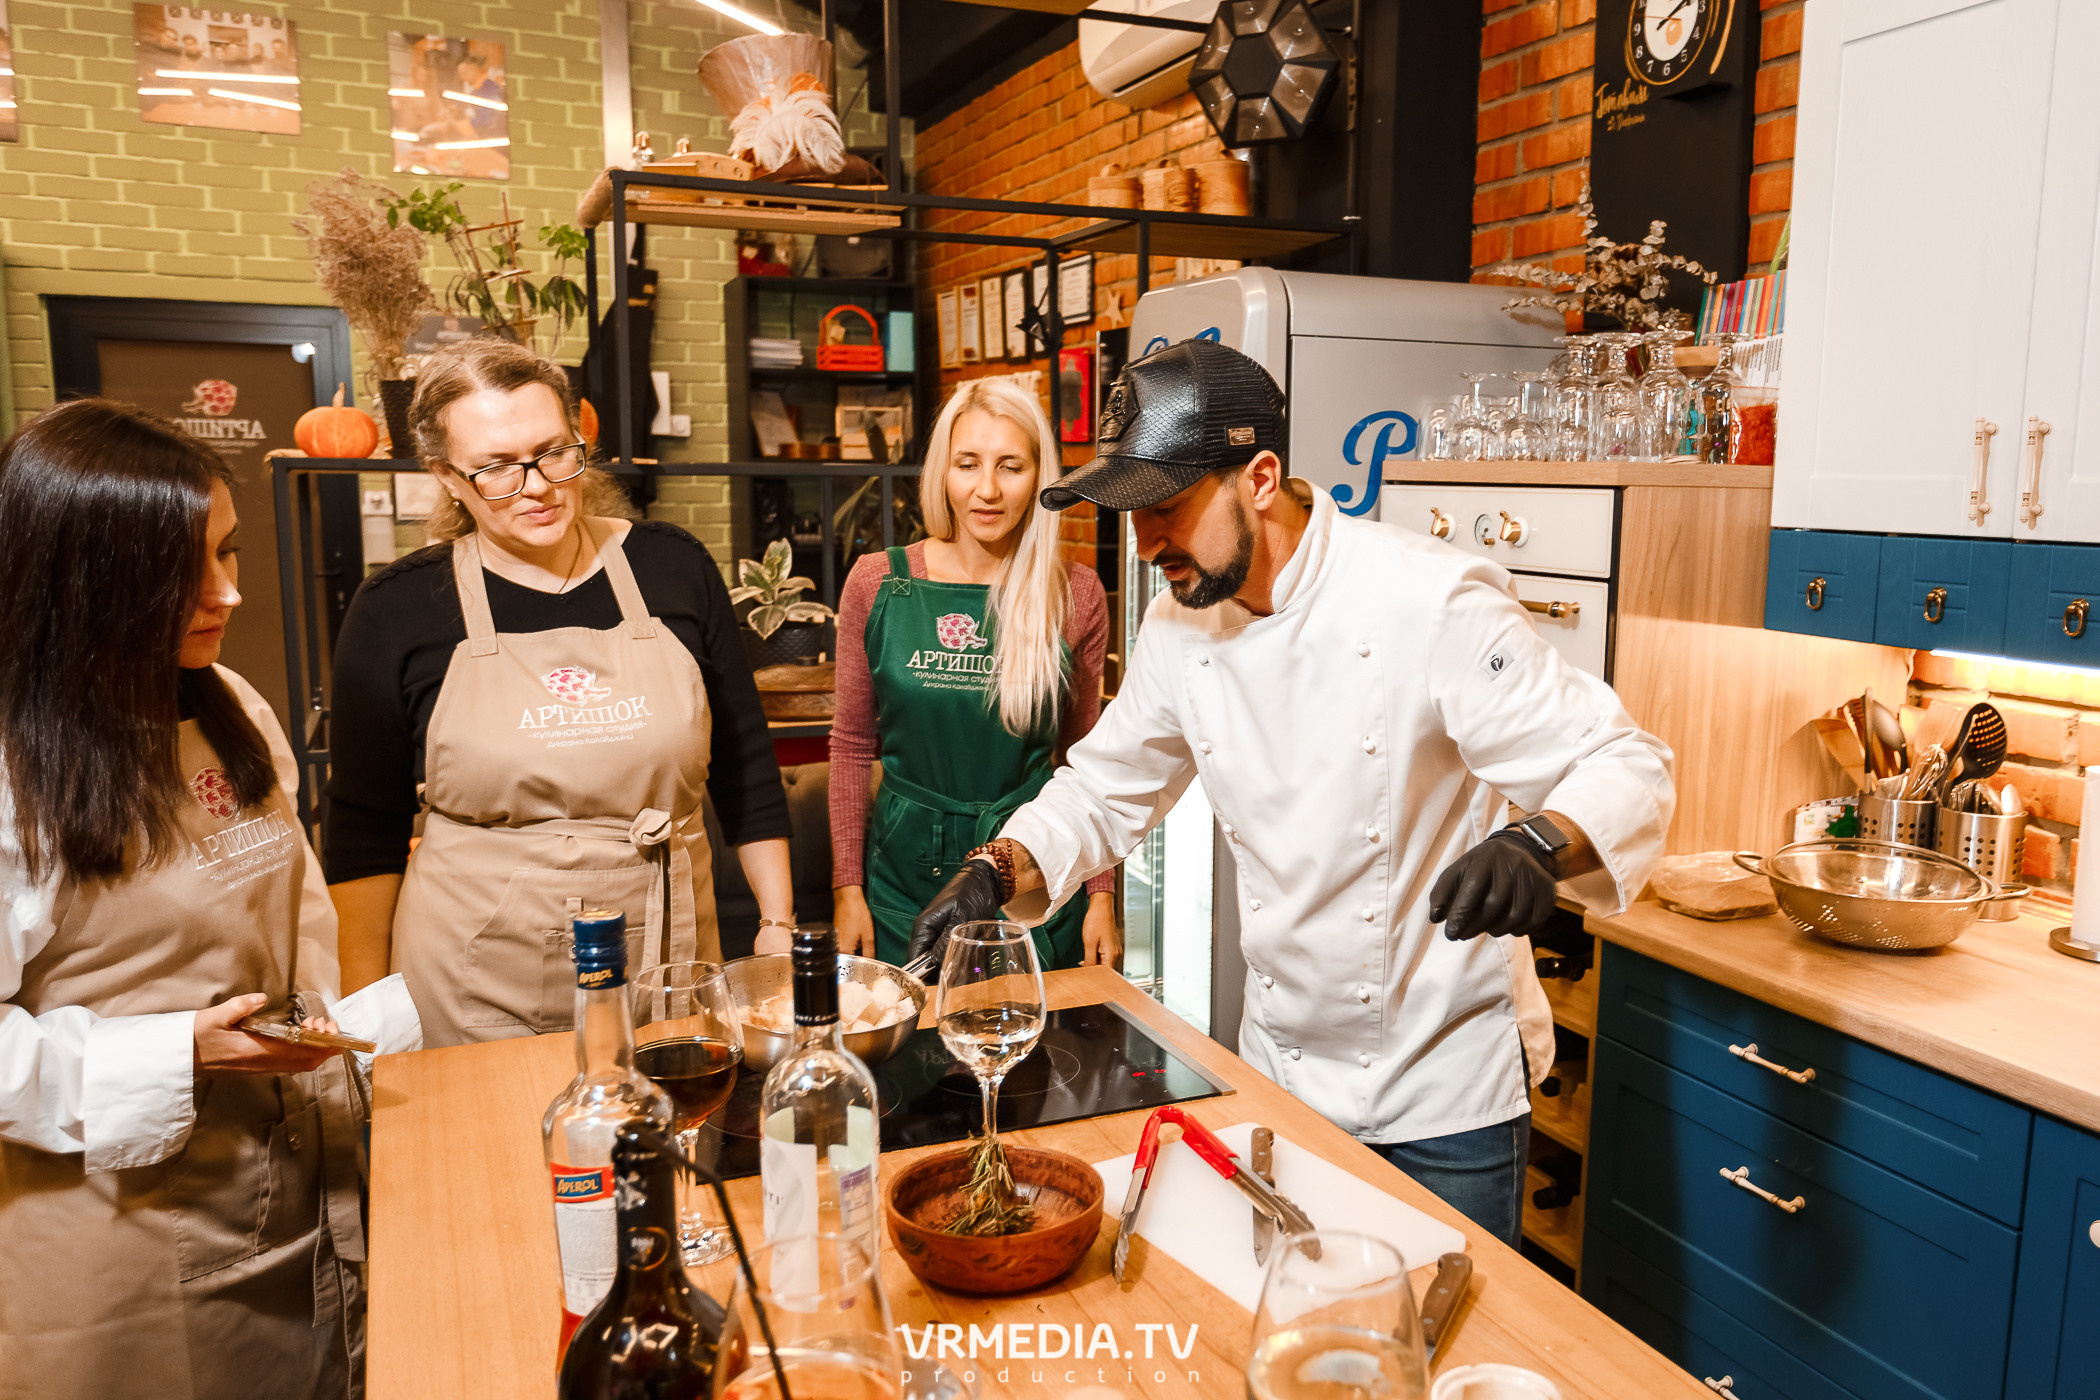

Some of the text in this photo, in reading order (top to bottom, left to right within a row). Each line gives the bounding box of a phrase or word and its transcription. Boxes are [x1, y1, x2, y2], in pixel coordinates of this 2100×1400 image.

[1634, 22, 1641, 36] 9
[1692, 26, 1700, 40] 4
[1636, 45, 1643, 59] 8
[1680, 49, 1688, 63] 5
[1647, 59, 1655, 73] 7
[1663, 62, 1671, 76] 6
[517, 696, 654, 730] АРТИШОК
[557, 1178, 599, 1195] APEROL
